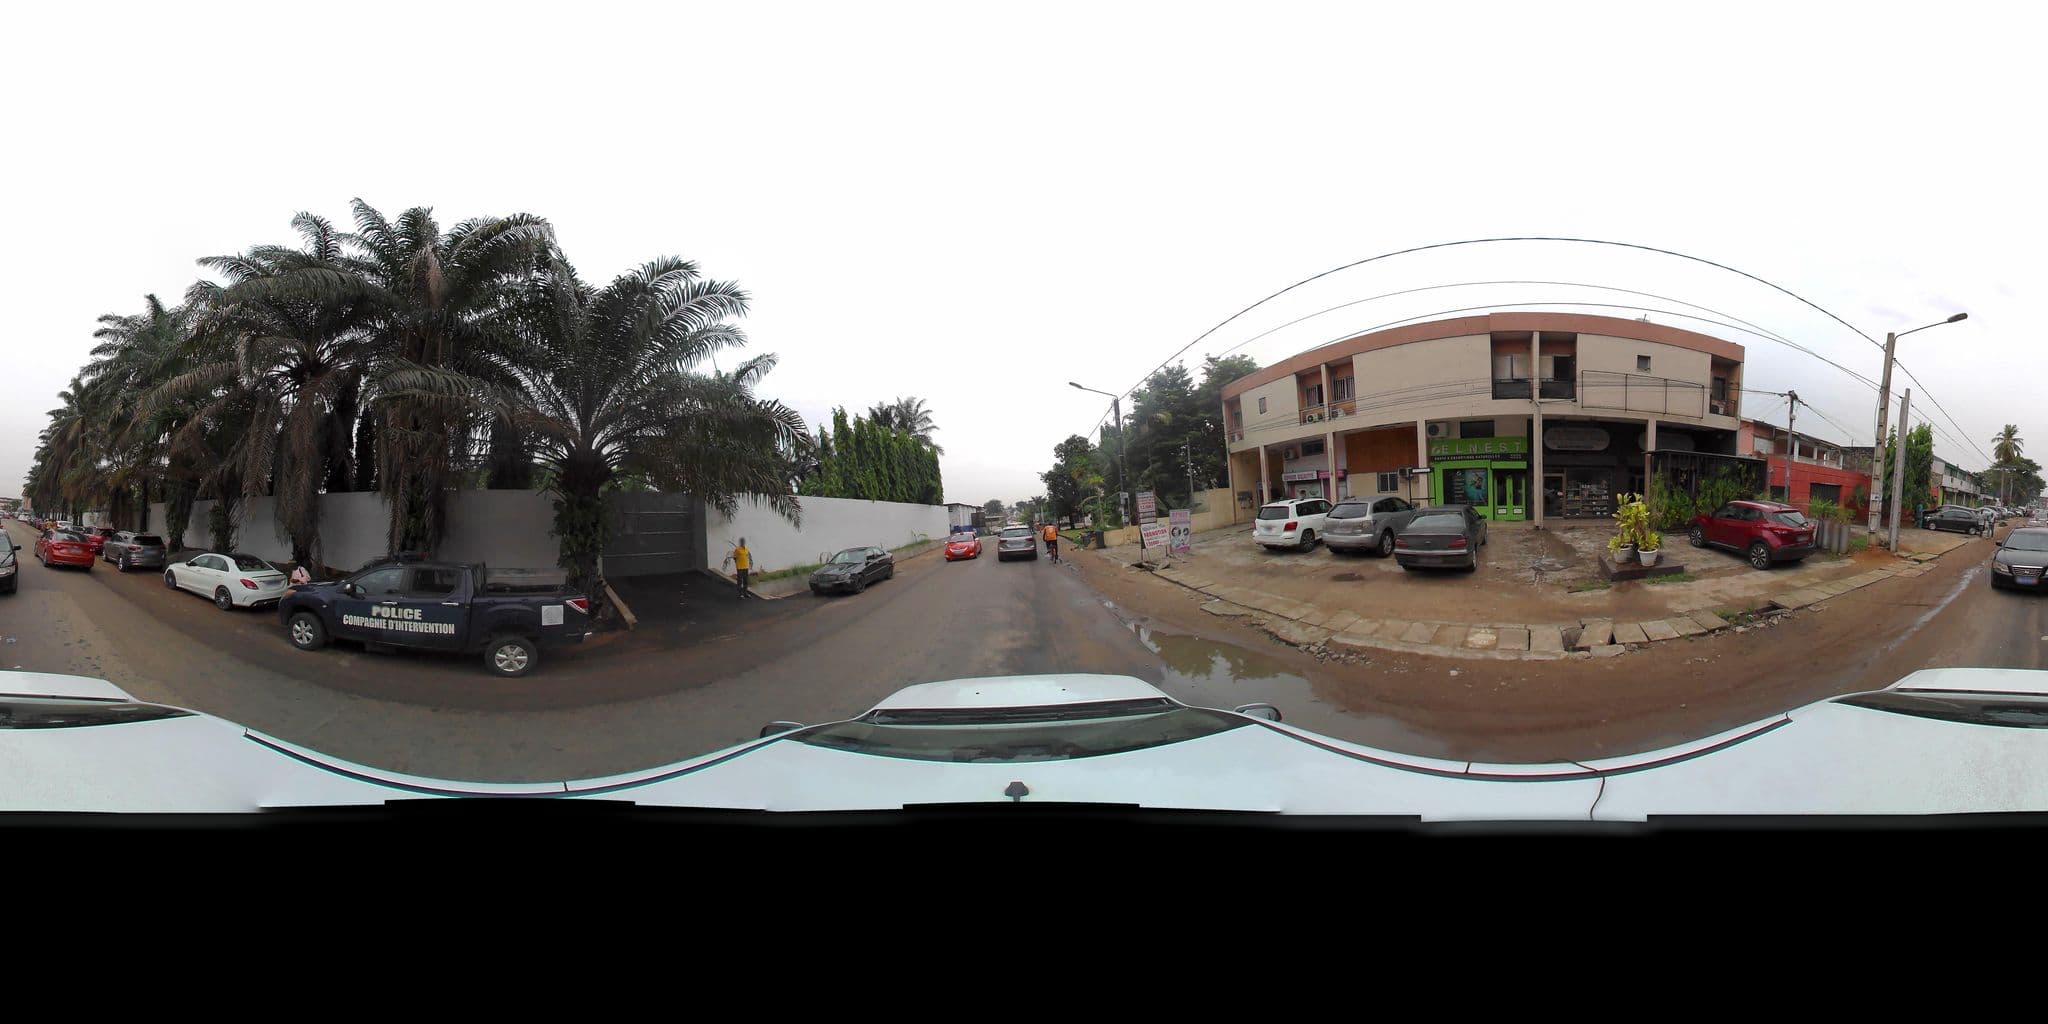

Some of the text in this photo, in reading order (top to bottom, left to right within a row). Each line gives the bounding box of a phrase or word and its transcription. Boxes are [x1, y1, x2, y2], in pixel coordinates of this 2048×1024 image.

[372, 606, 422, 620] POLICE
[343, 614, 455, 634] COMPAGNIE D'INTERVENTION
